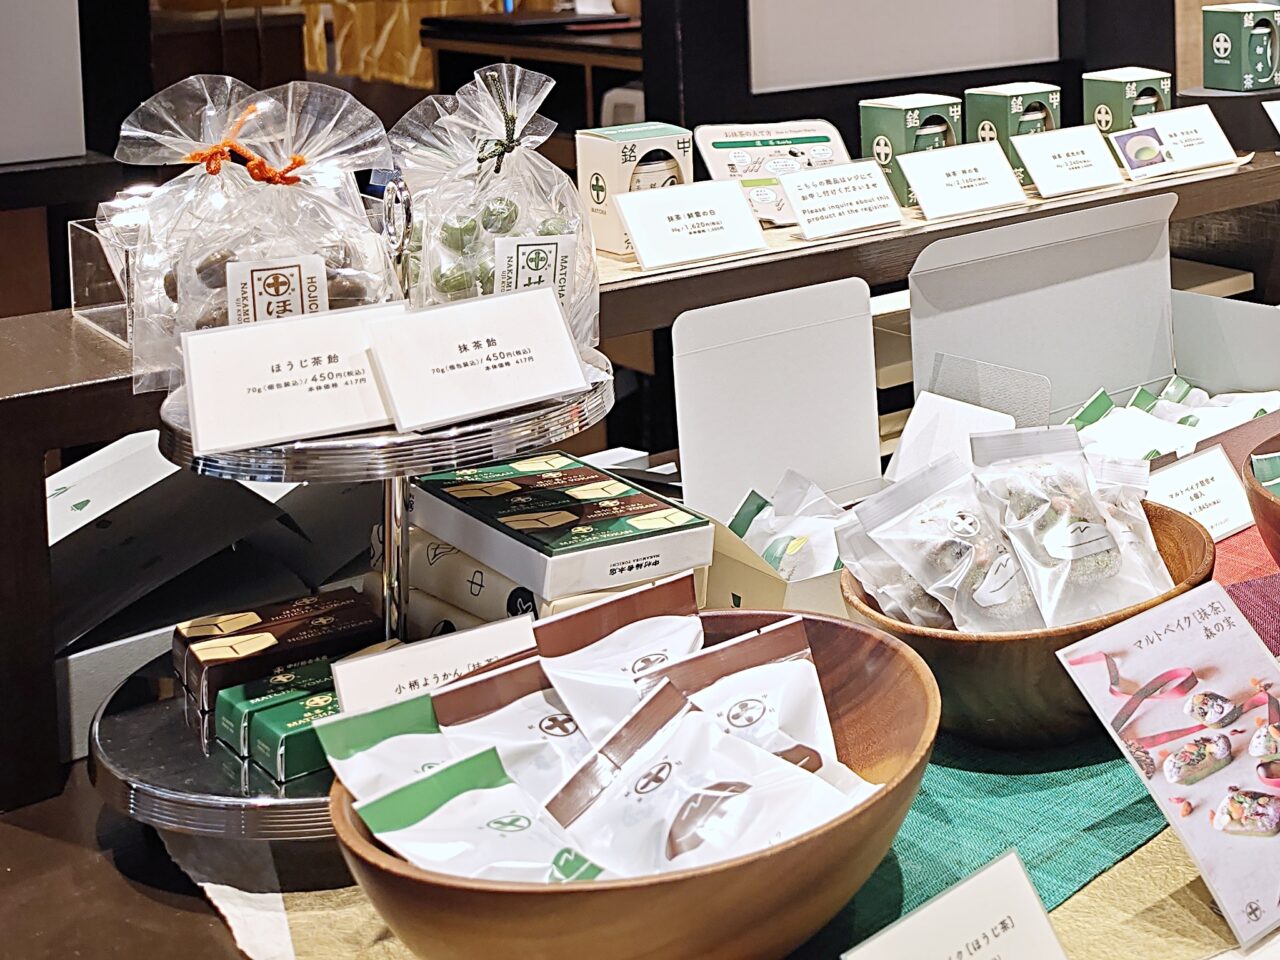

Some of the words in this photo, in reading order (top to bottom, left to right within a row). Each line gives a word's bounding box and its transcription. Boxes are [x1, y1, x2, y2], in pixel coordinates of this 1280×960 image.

[621, 143, 637, 165] 銘
[676, 137, 691, 157] 中
[802, 206, 826, 215] Please
[807, 213, 837, 224] product
[847, 207, 859, 215] the
[558, 255, 569, 299] MATCHA
[306, 275, 320, 314] HOJIC
[457, 337, 497, 355] 抹茶飴
[271, 353, 340, 374] ほうじ茶飴
[1202, 616, 1237, 640] 森の実
